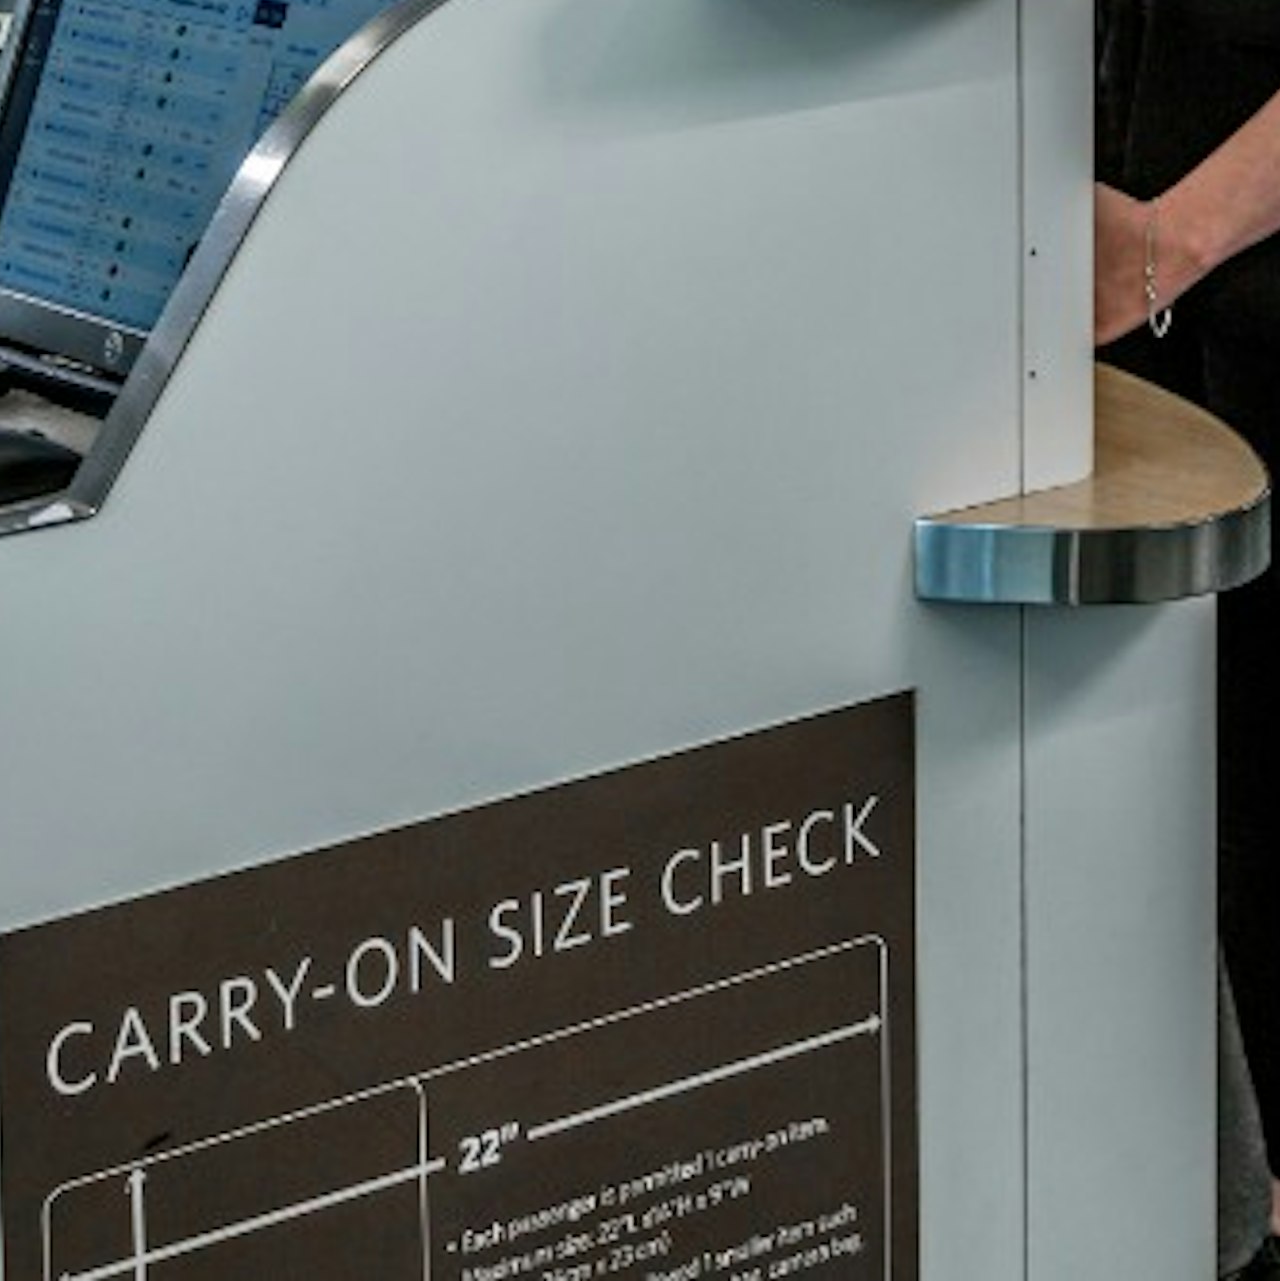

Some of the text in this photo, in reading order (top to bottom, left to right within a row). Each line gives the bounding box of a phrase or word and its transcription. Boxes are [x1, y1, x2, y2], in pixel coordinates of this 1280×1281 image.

[45, 793, 881, 1098] CARRY-ON SIZE CHECK
[460, 1219, 505, 1255] Each
